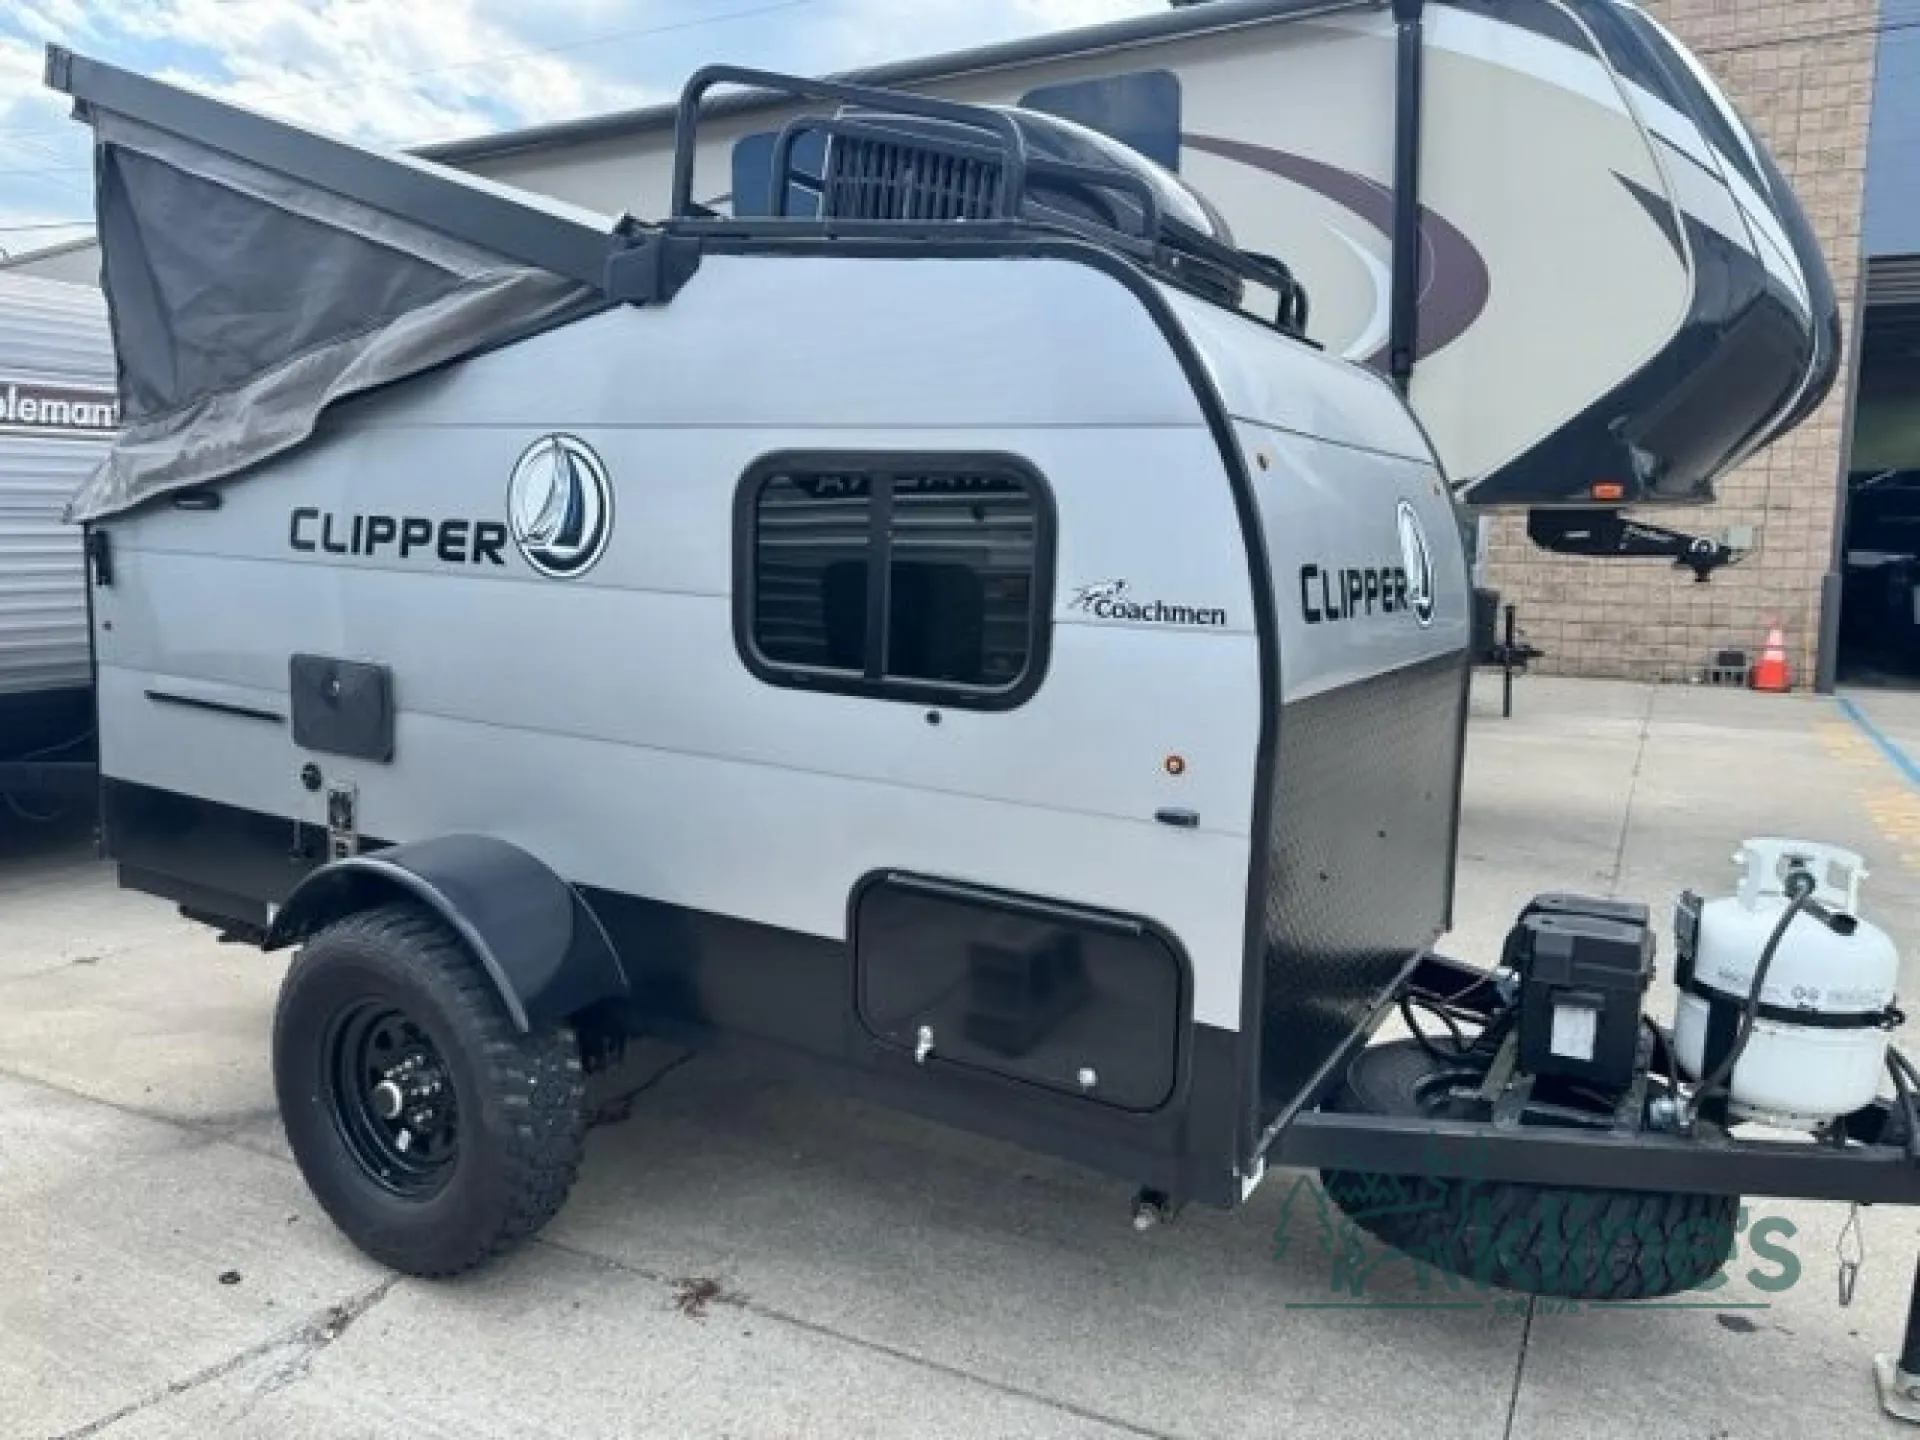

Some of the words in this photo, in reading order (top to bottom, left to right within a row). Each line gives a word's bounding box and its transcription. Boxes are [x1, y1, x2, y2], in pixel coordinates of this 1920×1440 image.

[290, 507, 507, 565] CLIPPER
[1094, 599, 1227, 625] Coachmen
[1301, 563, 1408, 624] CLIPPER
